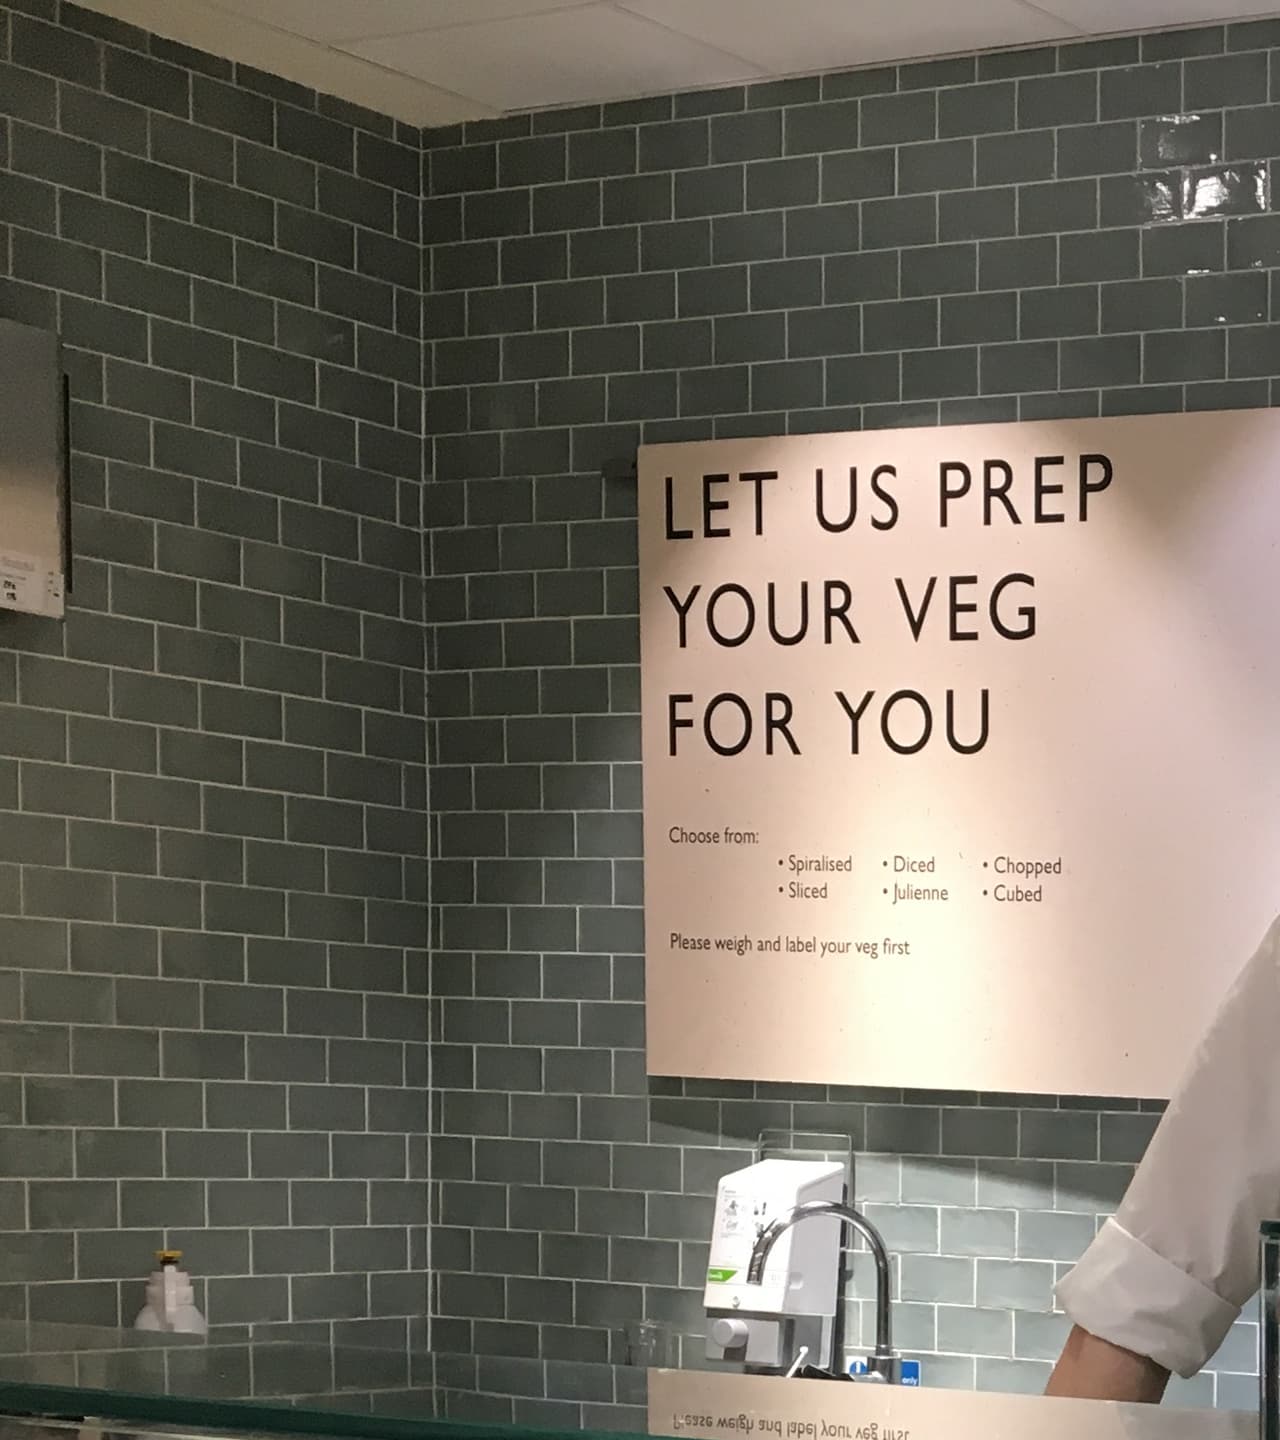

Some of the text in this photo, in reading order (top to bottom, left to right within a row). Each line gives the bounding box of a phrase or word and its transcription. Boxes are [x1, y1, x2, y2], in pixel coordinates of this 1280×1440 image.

[663, 453, 1114, 541] LET US PREP
[662, 572, 1037, 648] YOUR VEG
[669, 688, 990, 757] FOR YOU
[668, 827, 760, 845] Choose from:
[787, 855, 853, 876] Spiralised
[893, 856, 936, 874] Diced
[993, 857, 1062, 878] Chopped
[788, 882, 829, 900] Sliced
[892, 884, 949, 904] Julienne
[993, 884, 1043, 903] Cubed
[669, 934, 911, 959] Please weigh and label your veg first
[901, 1374, 918, 1386] only
